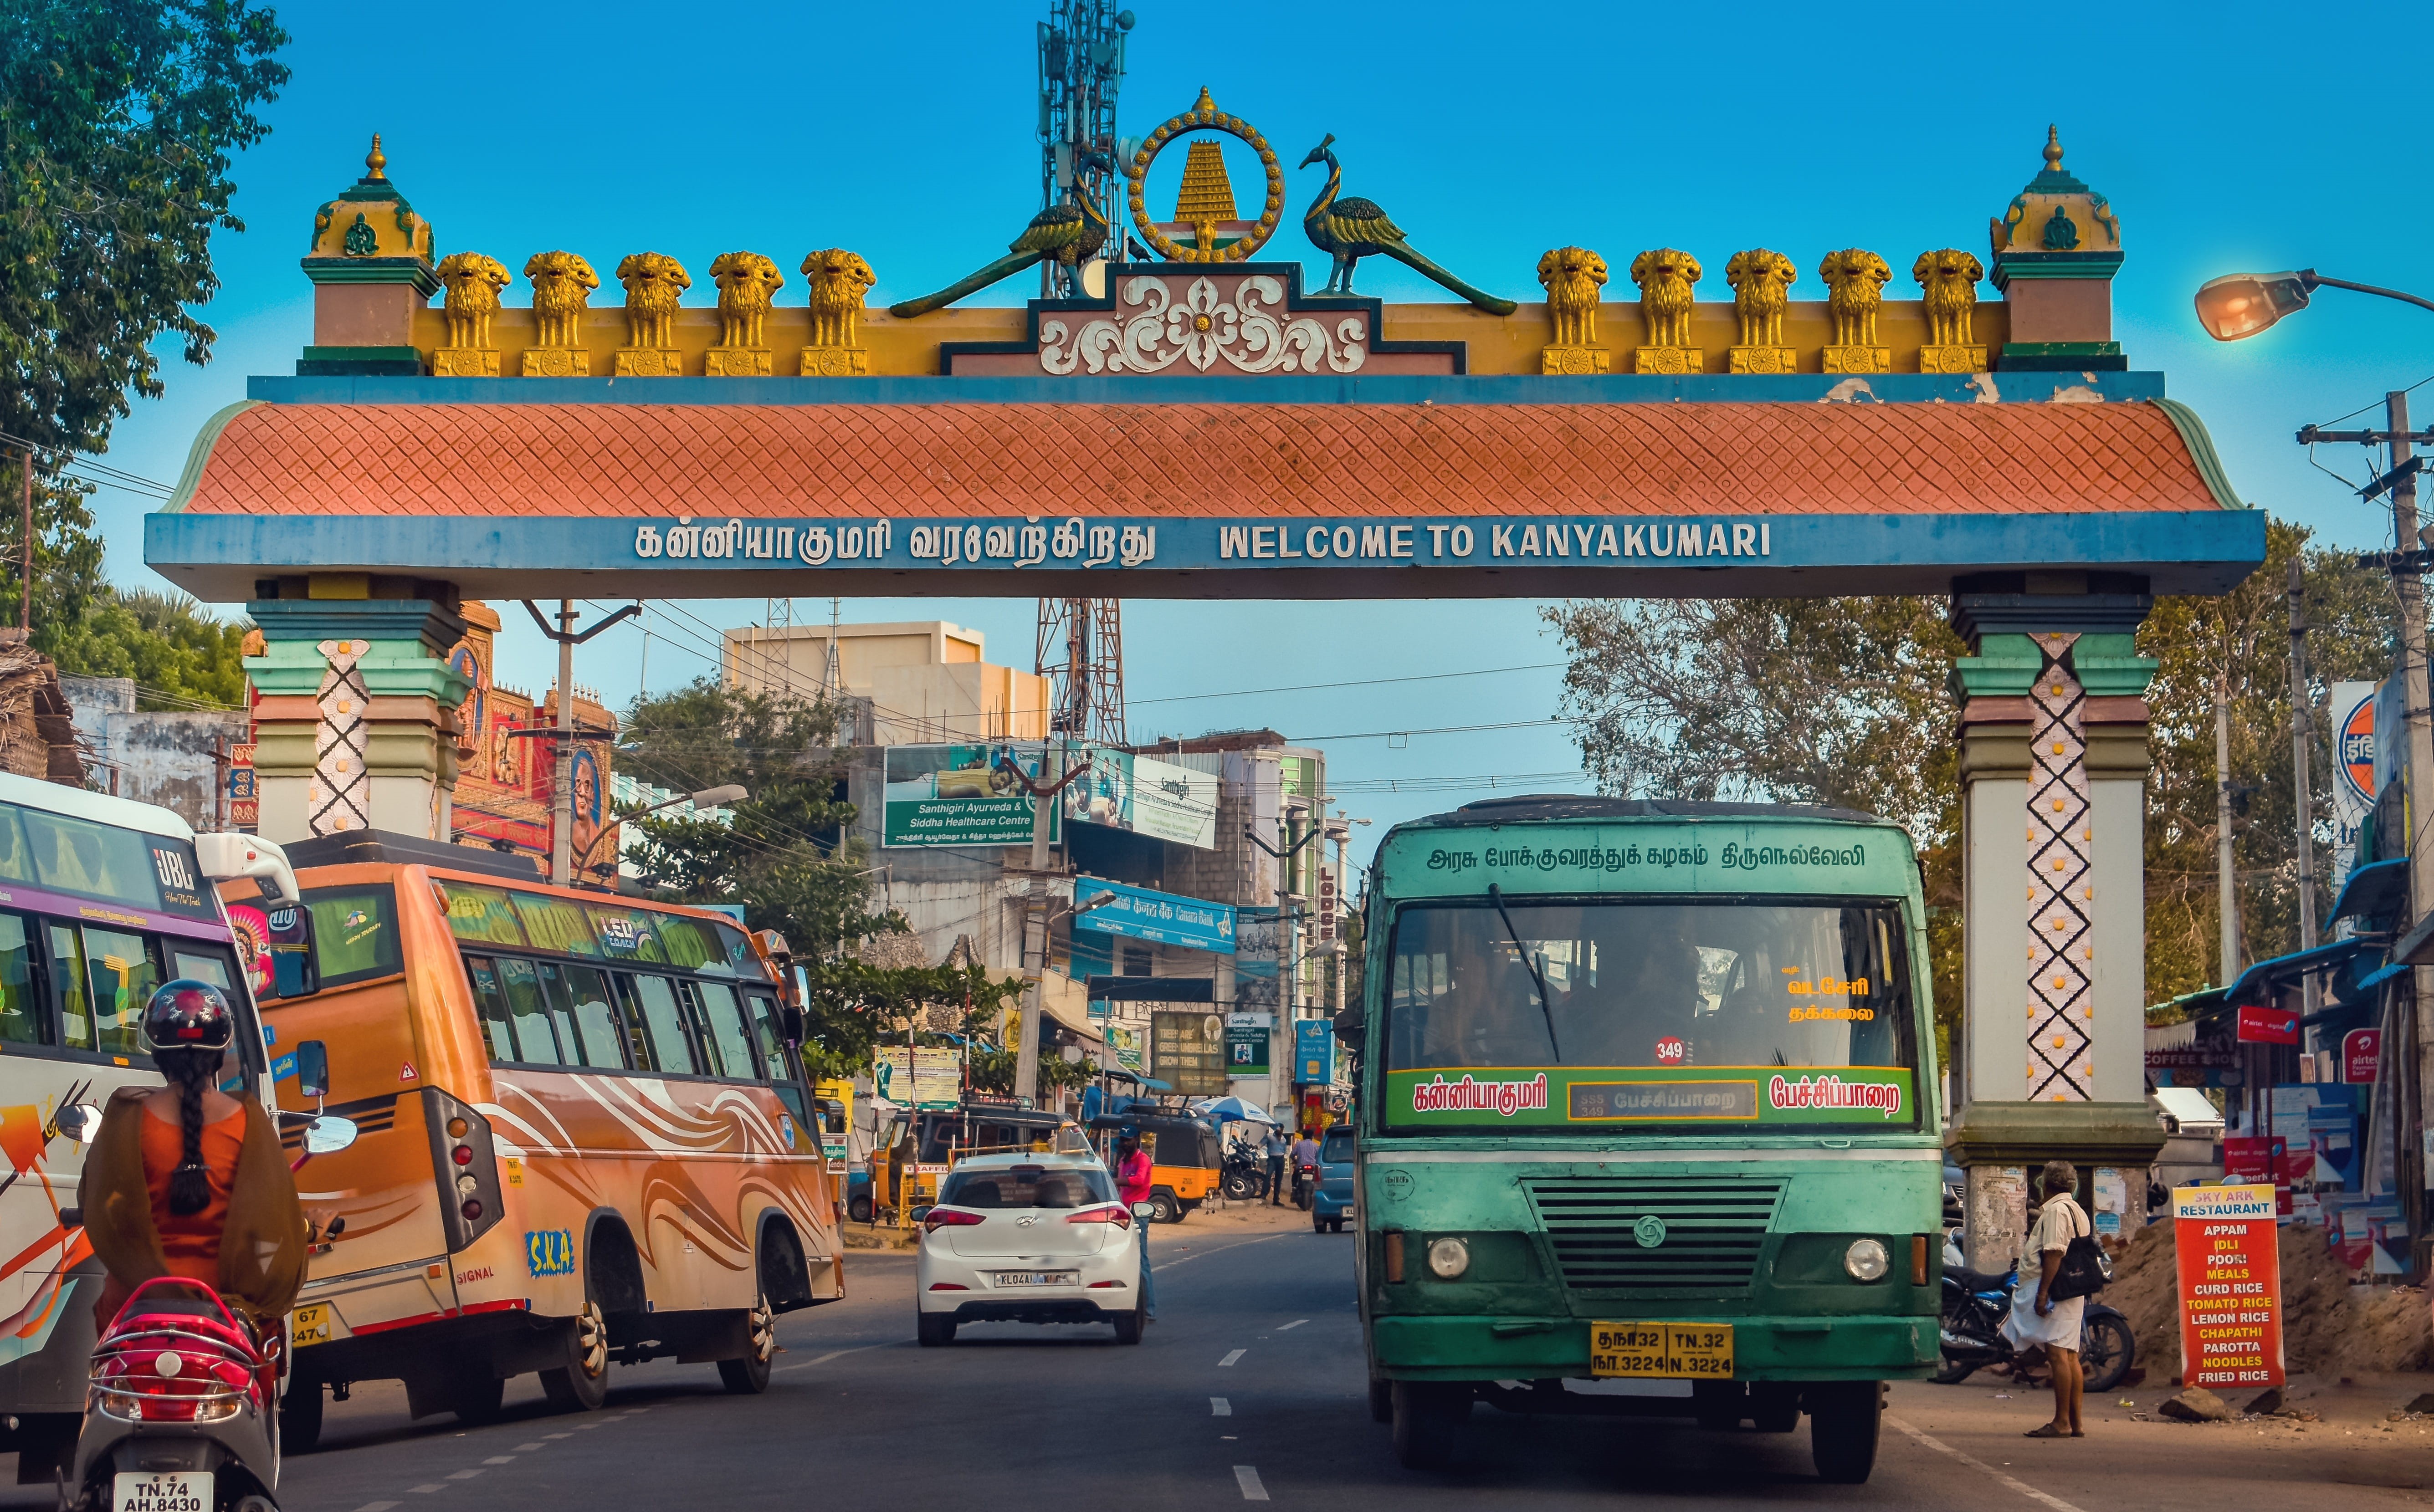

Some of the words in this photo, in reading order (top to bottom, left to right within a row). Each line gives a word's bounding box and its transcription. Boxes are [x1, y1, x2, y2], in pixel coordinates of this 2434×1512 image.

[636, 516, 892, 566] கன்னியாகுமரி
[911, 516, 1156, 568] வரவேற்கிறது
[1220, 524, 1414, 559] WELCOME
[1427, 524, 1474, 558] TO
[1491, 522, 1771, 558] KANYAKUMARI
[919, 803, 964, 814] Santhigiri
[967, 802, 1012, 813] Ayurveda
[1015, 802, 1021, 811] &
[910, 817, 943, 828] Siddha
[945, 817, 996, 826] Healthcare
[999, 816, 1030, 825] Centre
[1426, 849, 1478, 873] அரசு
[1485, 843, 1642, 873] போக்குவரத்துக்
[1647, 844, 1708, 868] கழகம்
[1722, 842, 1865, 870] திருநெல்வேலி
[154, 849, 195, 890] JBL
[165, 891, 177, 903] Here
[177, 894, 187, 904] The
[1321, 867, 1334, 940] LODGE
[1176, 905, 1198, 923] Canara
[1199, 909, 1214, 927] Bank
[346, 934, 361, 945] HAPPY
[361, 922, 381, 937] JOURNEY
[600, 916, 634, 938] LED
[610, 937, 635, 949] COACH
[1788, 977, 1869, 995] வடசேரி
[1788, 1004, 1874, 1024] தக்கலை
[1180, 1042, 1219, 1054] UMBRELLAS
[1657, 1042, 1683, 1058] 349
[1159, 1056, 1178, 1066] GROW
[1180, 1057, 1198, 1067] THEM
[2144, 1054, 2196, 1065] COFFEE
[2352, 1055, 2378, 1065] airtel
[1413, 1073, 1548, 1116] கன்னியாகுமரி
[1580, 1093, 1604, 1105] SSS
[1614, 1090, 1736, 1111] பேச்சிப்பாறை
[1769, 1075, 1901, 1119] பேச்சிப்பாறை
[1581, 1106, 1604, 1117] 349
[2194, 1192, 2221, 1204] SKY
[2226, 1190, 2254, 1202] ARK
[2180, 1202, 2270, 1216] RESTAURANT
[2204, 1224, 2247, 1236] APPAM
[531, 1232, 570, 1272] S.K.A
[2214, 1239, 2239, 1251] IDLI
[456, 1266, 494, 1285] SIGNAL
[2207, 1268, 2250, 1280] MEALS
[2194, 1283, 2230, 1295] CURD
[2234, 1282, 2263, 1293] RICE
[2187, 1297, 2240, 1310] TOMATO
[2243, 1296, 2272, 1308] RICE
[299, 1309, 318, 1323] 67
[2191, 1313, 2236, 1325] LEMON
[2240, 1311, 2270, 1323] RICE
[2199, 1327, 2263, 1339] CHAPATHI
[1675, 1333, 1725, 1349] TN.32
[2203, 1342, 2261, 1354] PAROTTA
[1670, 1357, 1731, 1373] N.3224
[2203, 1355, 2263, 1368] NOODLES
[2198, 1371, 2235, 1383] FRIED
[2239, 1370, 2269, 1382] RICE
[135, 1482, 189, 1497] TN.74
[124, 1497, 201, 1512] AH.8430
